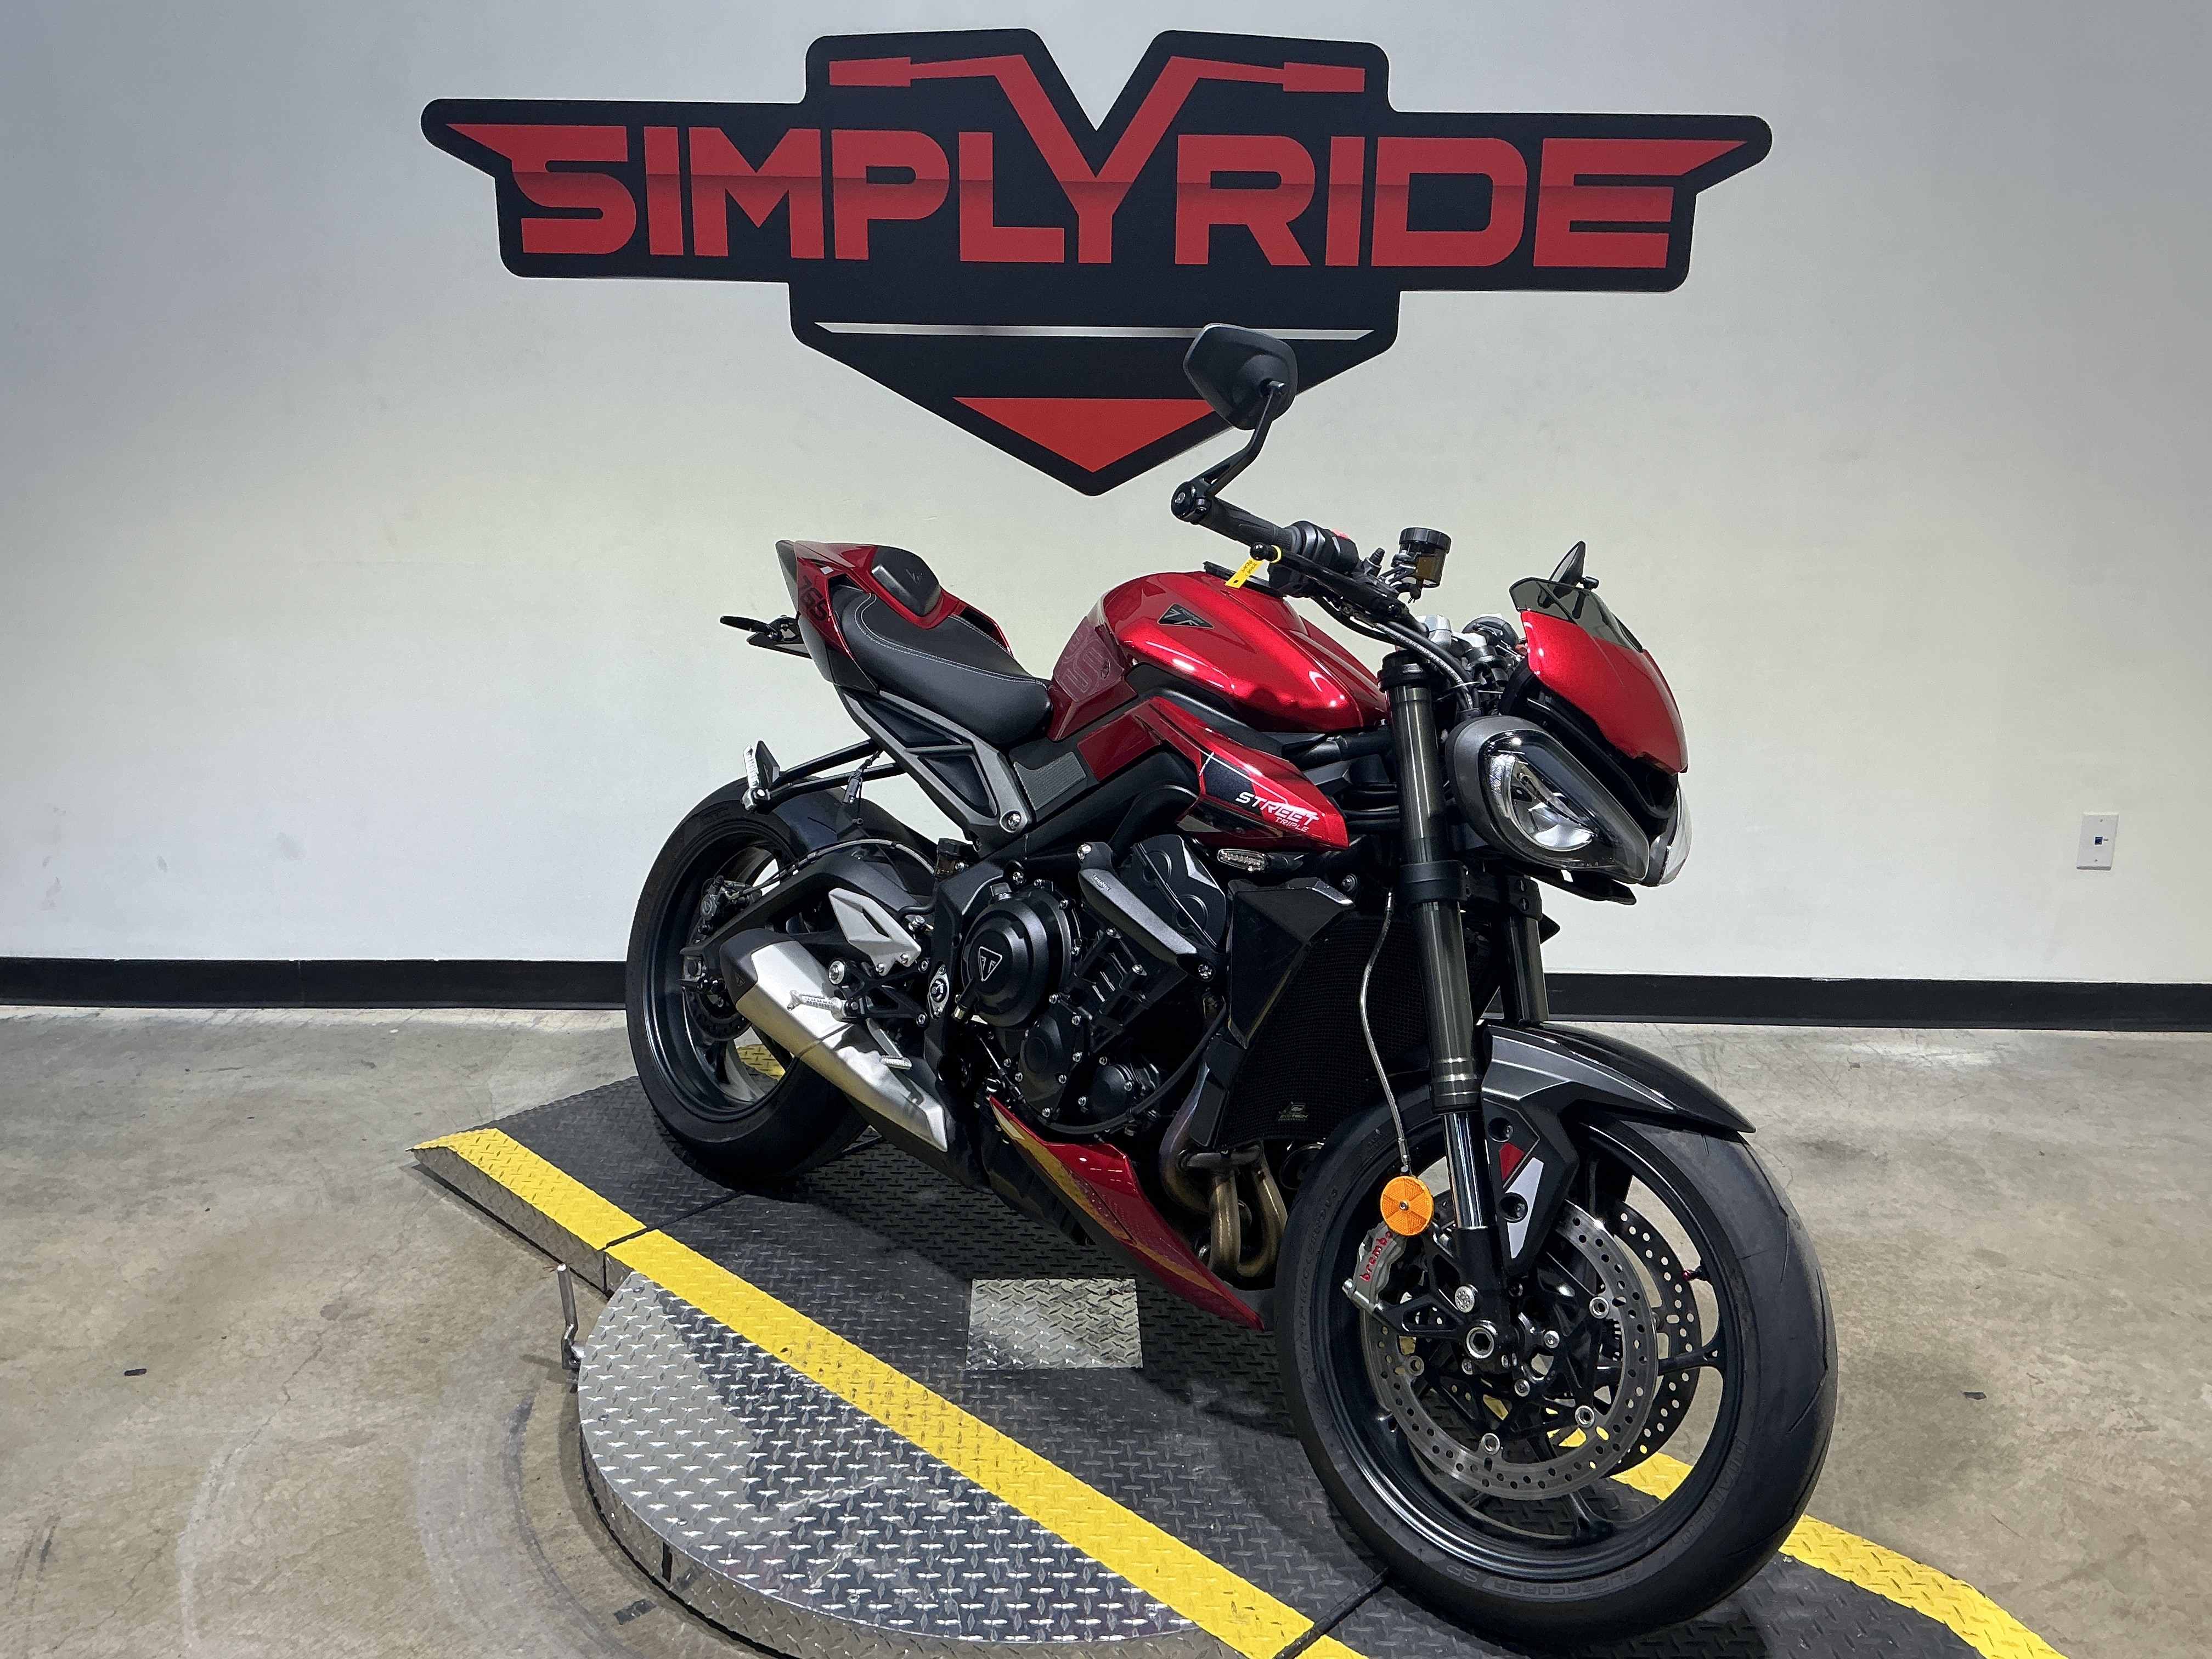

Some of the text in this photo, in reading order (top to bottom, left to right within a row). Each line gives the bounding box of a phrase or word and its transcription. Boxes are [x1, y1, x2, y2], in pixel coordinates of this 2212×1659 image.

[445, 54, 1748, 268] SIMPLYRIDE
[799, 575, 827, 620] 765
[1235, 792, 1319, 826] STREET
[1275, 816, 1310, 833] TRIPLE
[1359, 1231, 1393, 1282] brembo
[1445, 1438, 1748, 1596] DIABLO SUPERCORSA SP
